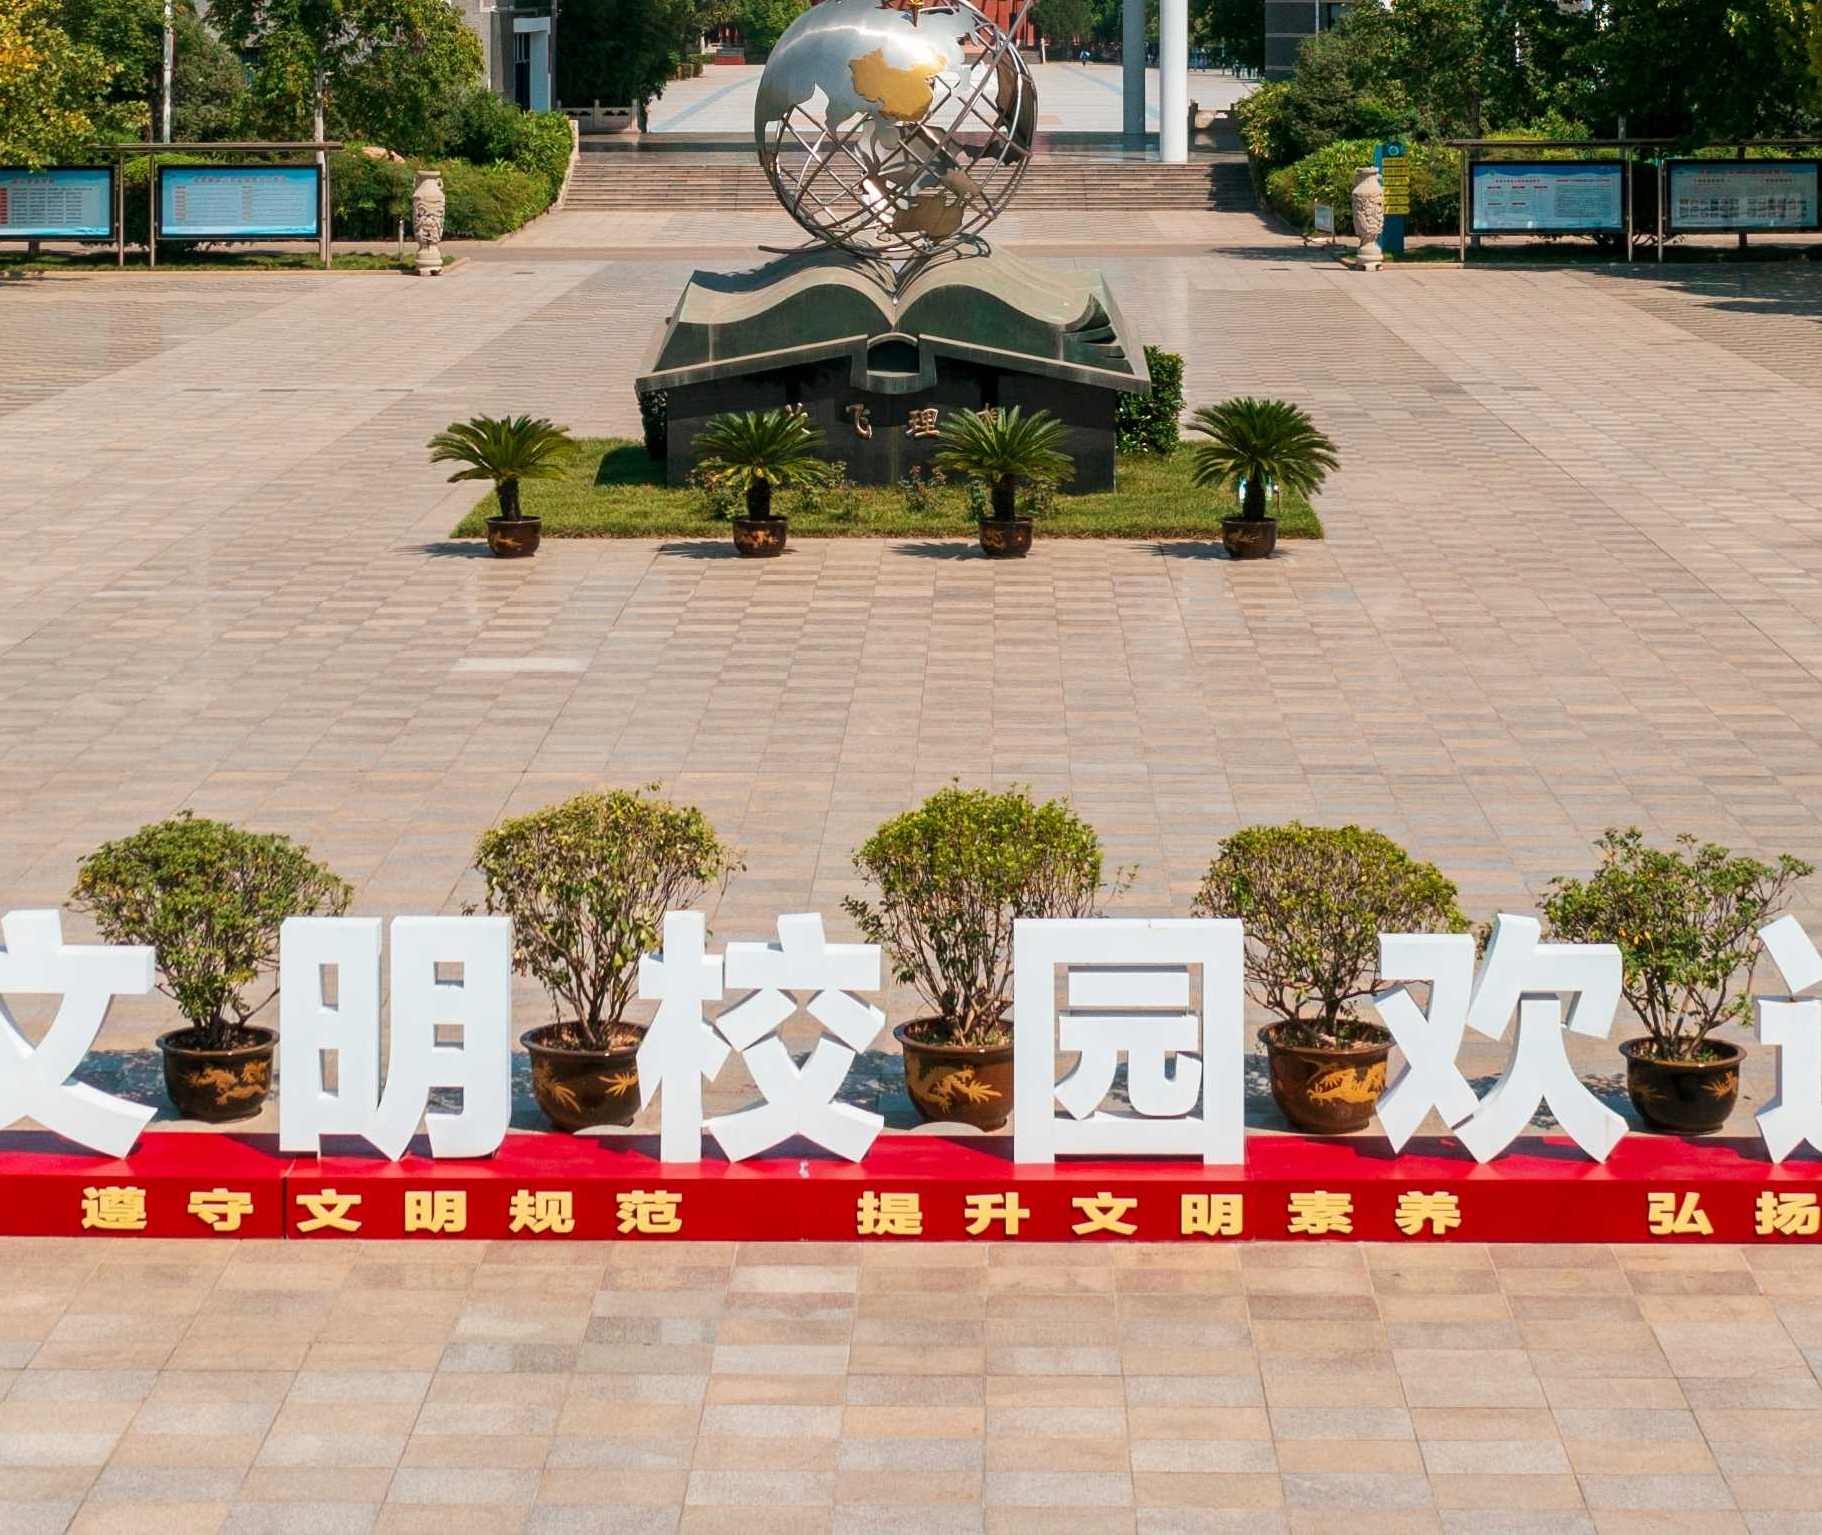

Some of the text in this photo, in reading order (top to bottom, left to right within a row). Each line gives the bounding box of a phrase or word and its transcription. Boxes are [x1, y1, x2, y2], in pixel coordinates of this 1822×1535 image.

[82, 1185, 685, 1235] 遵守文明规范
[856, 1191, 1465, 1237] 提升文明素养
